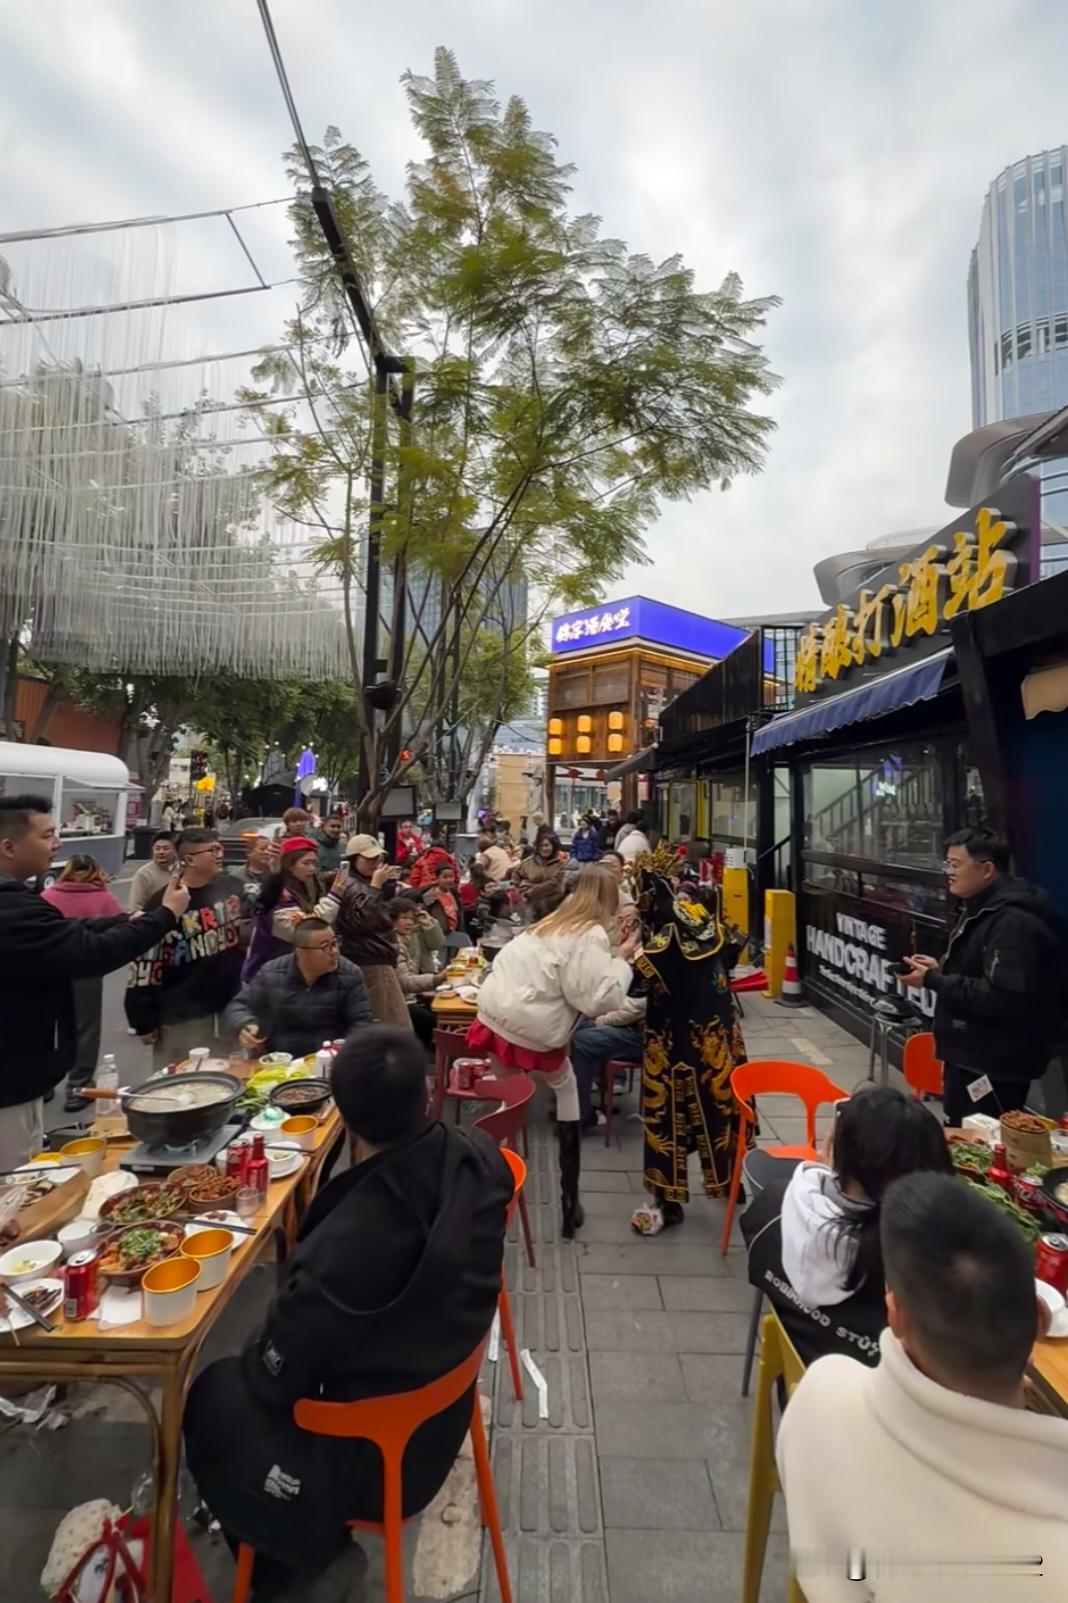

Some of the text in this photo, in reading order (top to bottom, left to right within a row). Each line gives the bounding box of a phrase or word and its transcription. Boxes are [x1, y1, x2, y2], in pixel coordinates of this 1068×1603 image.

[794, 507, 1011, 693] 精酿打酒站
[836, 912, 888, 950] VINTAGE
